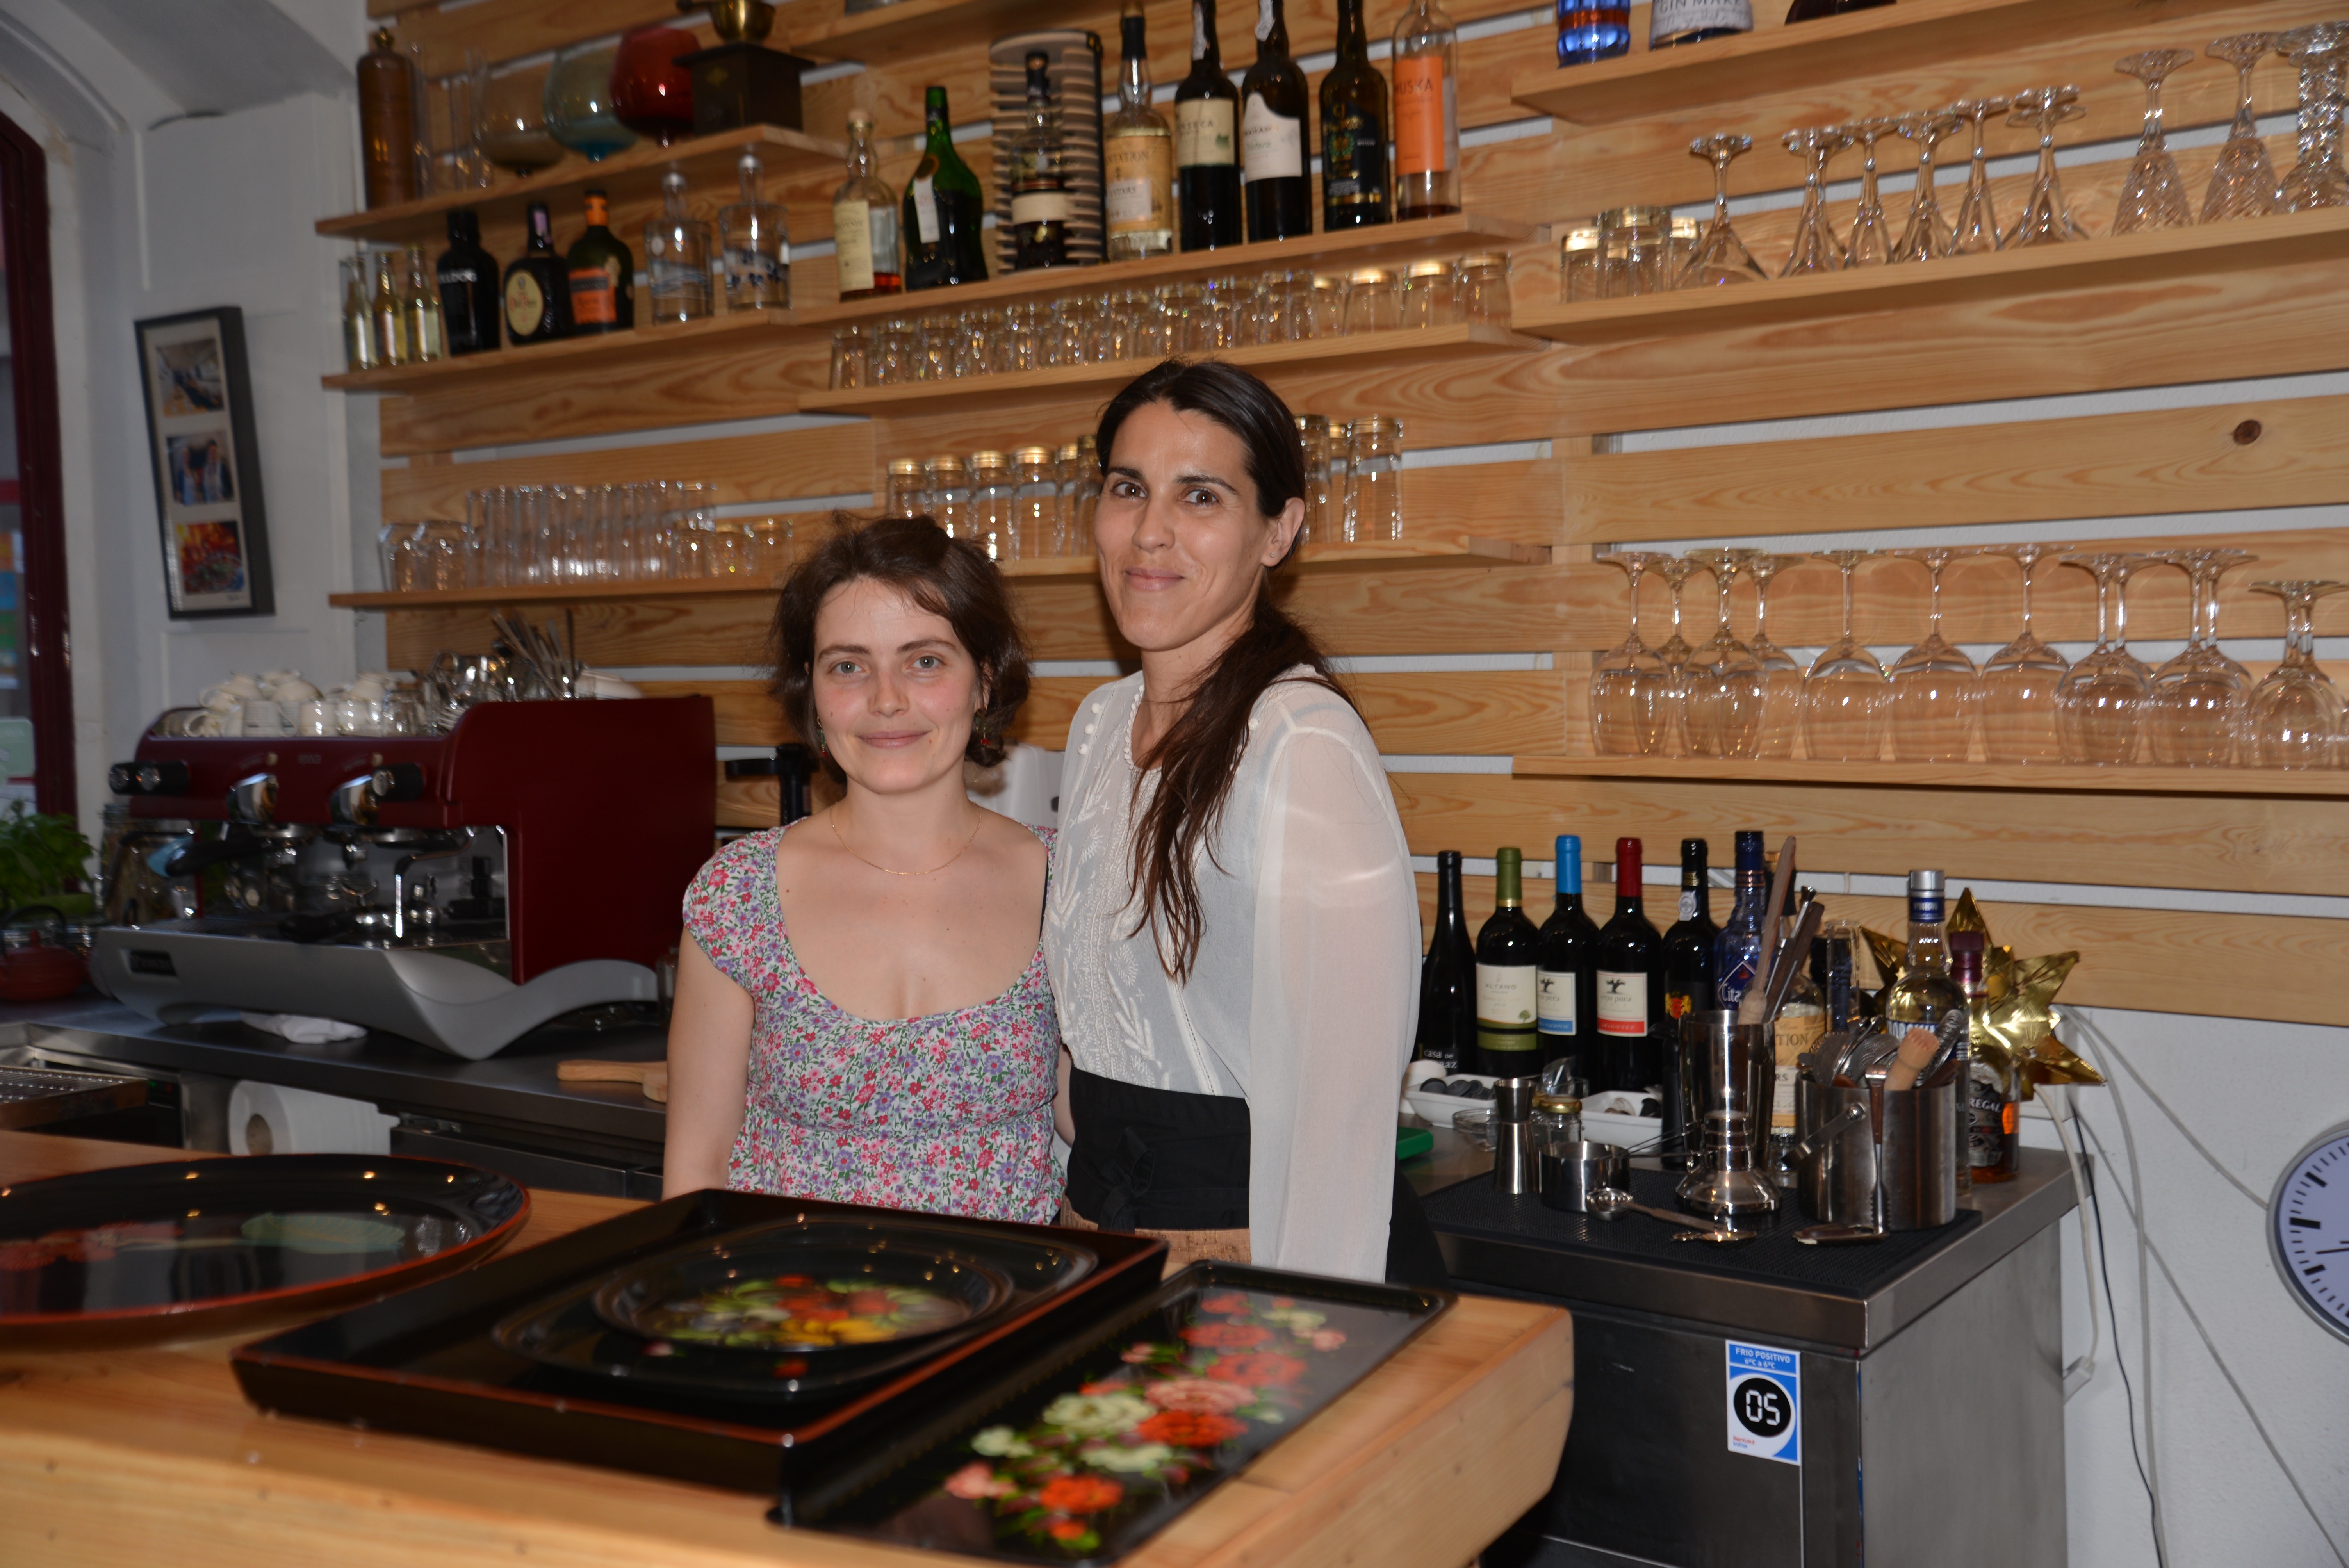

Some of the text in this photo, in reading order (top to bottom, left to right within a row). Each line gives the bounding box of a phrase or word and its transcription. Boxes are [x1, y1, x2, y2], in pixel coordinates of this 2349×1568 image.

[1969, 1097, 2002, 1113] REGAL
[1735, 1346, 1791, 1364] FRIO POSITIVO
[1745, 1389, 1780, 1426] 05
